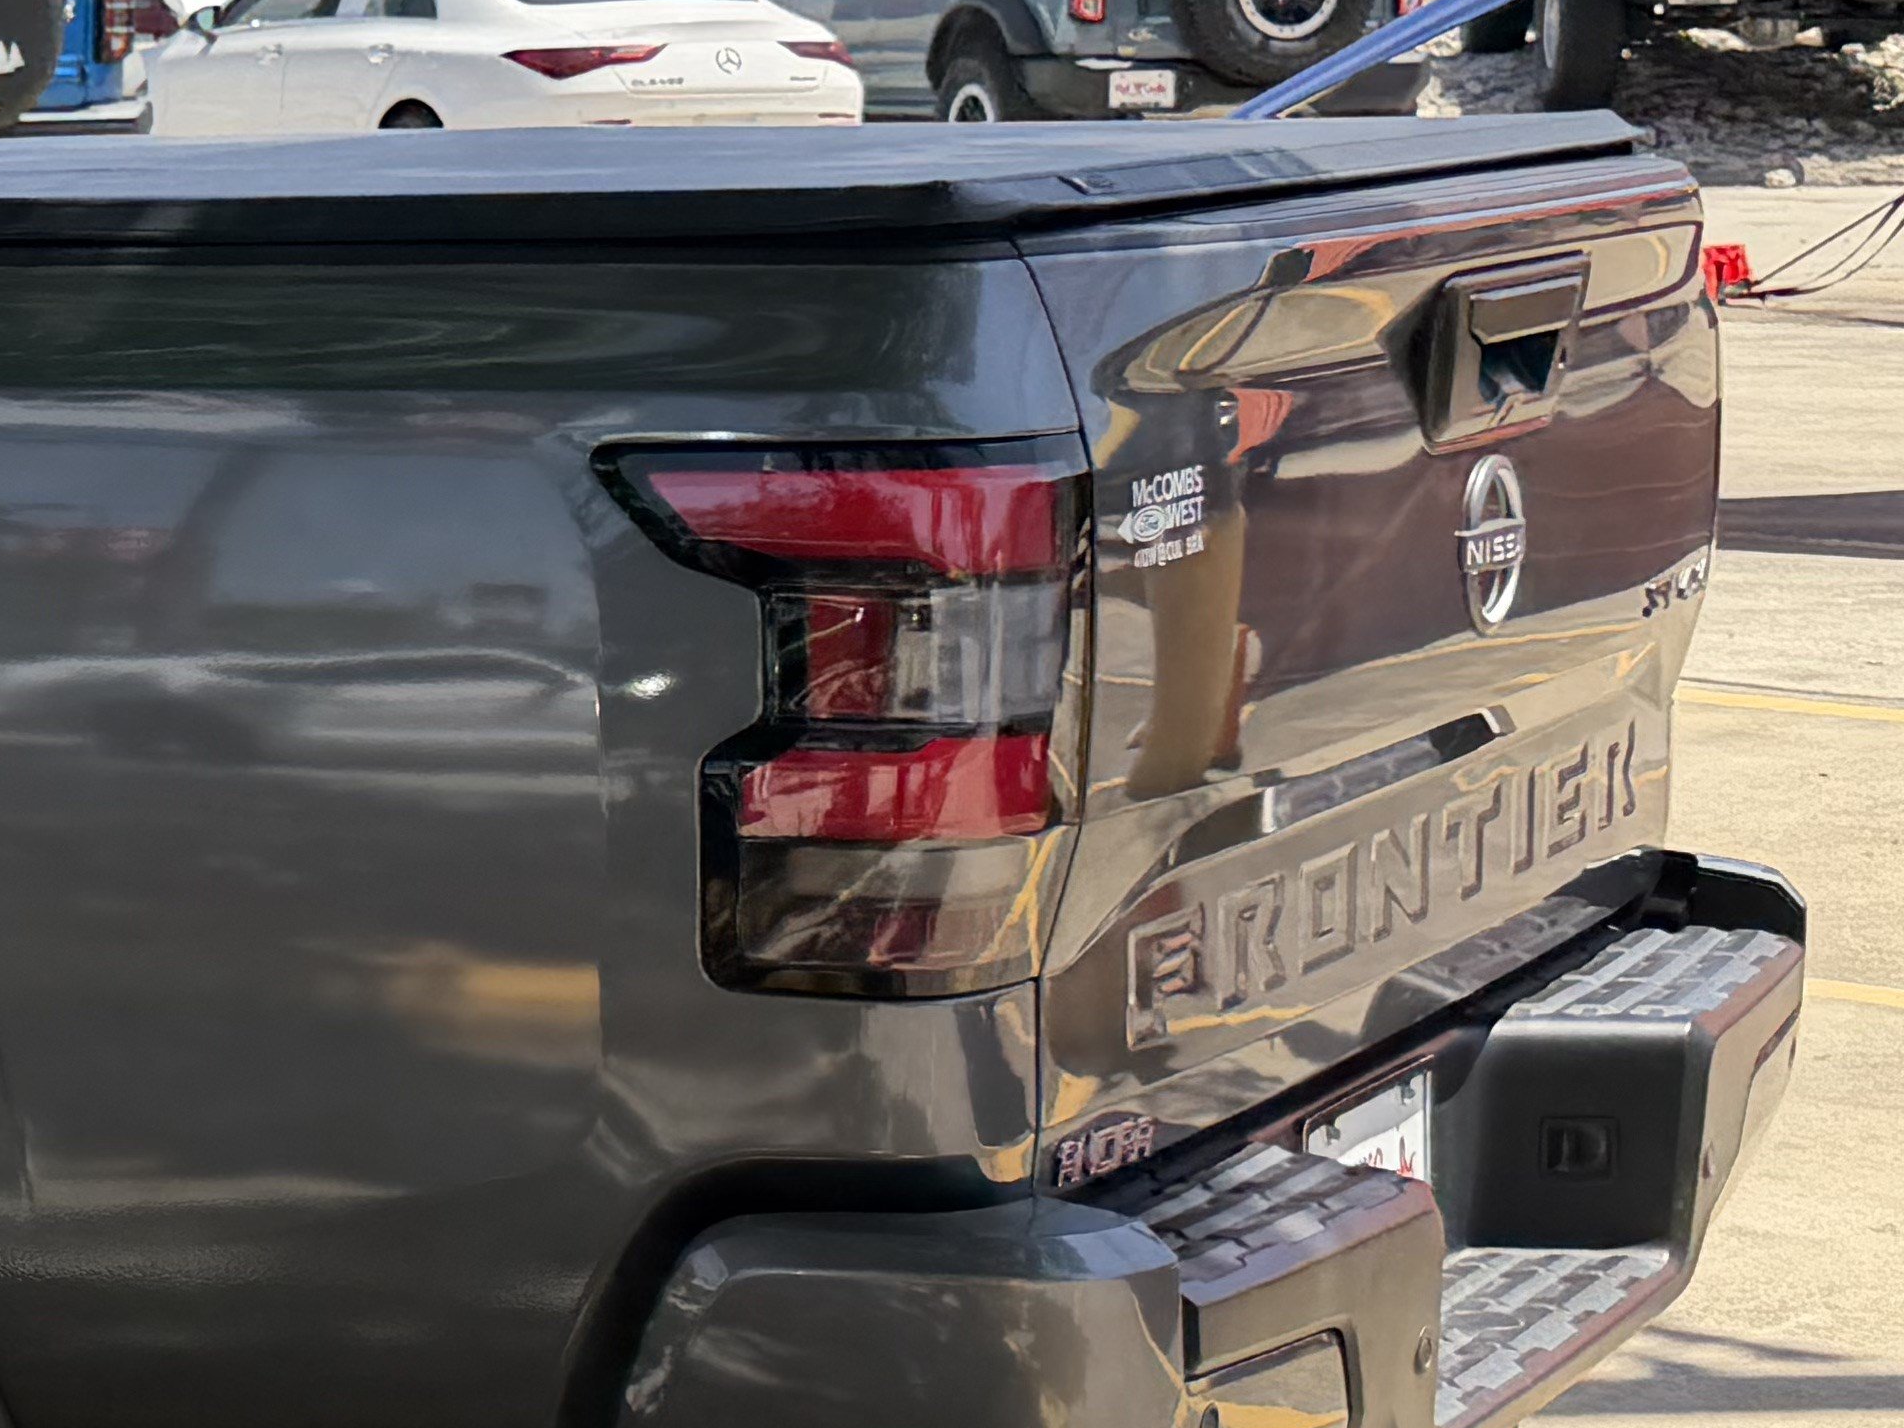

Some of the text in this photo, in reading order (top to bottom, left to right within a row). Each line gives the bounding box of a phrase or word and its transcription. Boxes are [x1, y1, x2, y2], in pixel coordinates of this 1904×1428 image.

[1132, 464, 1204, 507] McCOMBS
[1164, 495, 1205, 530] WEST
[1127, 717, 1638, 1053] FRONTIER
